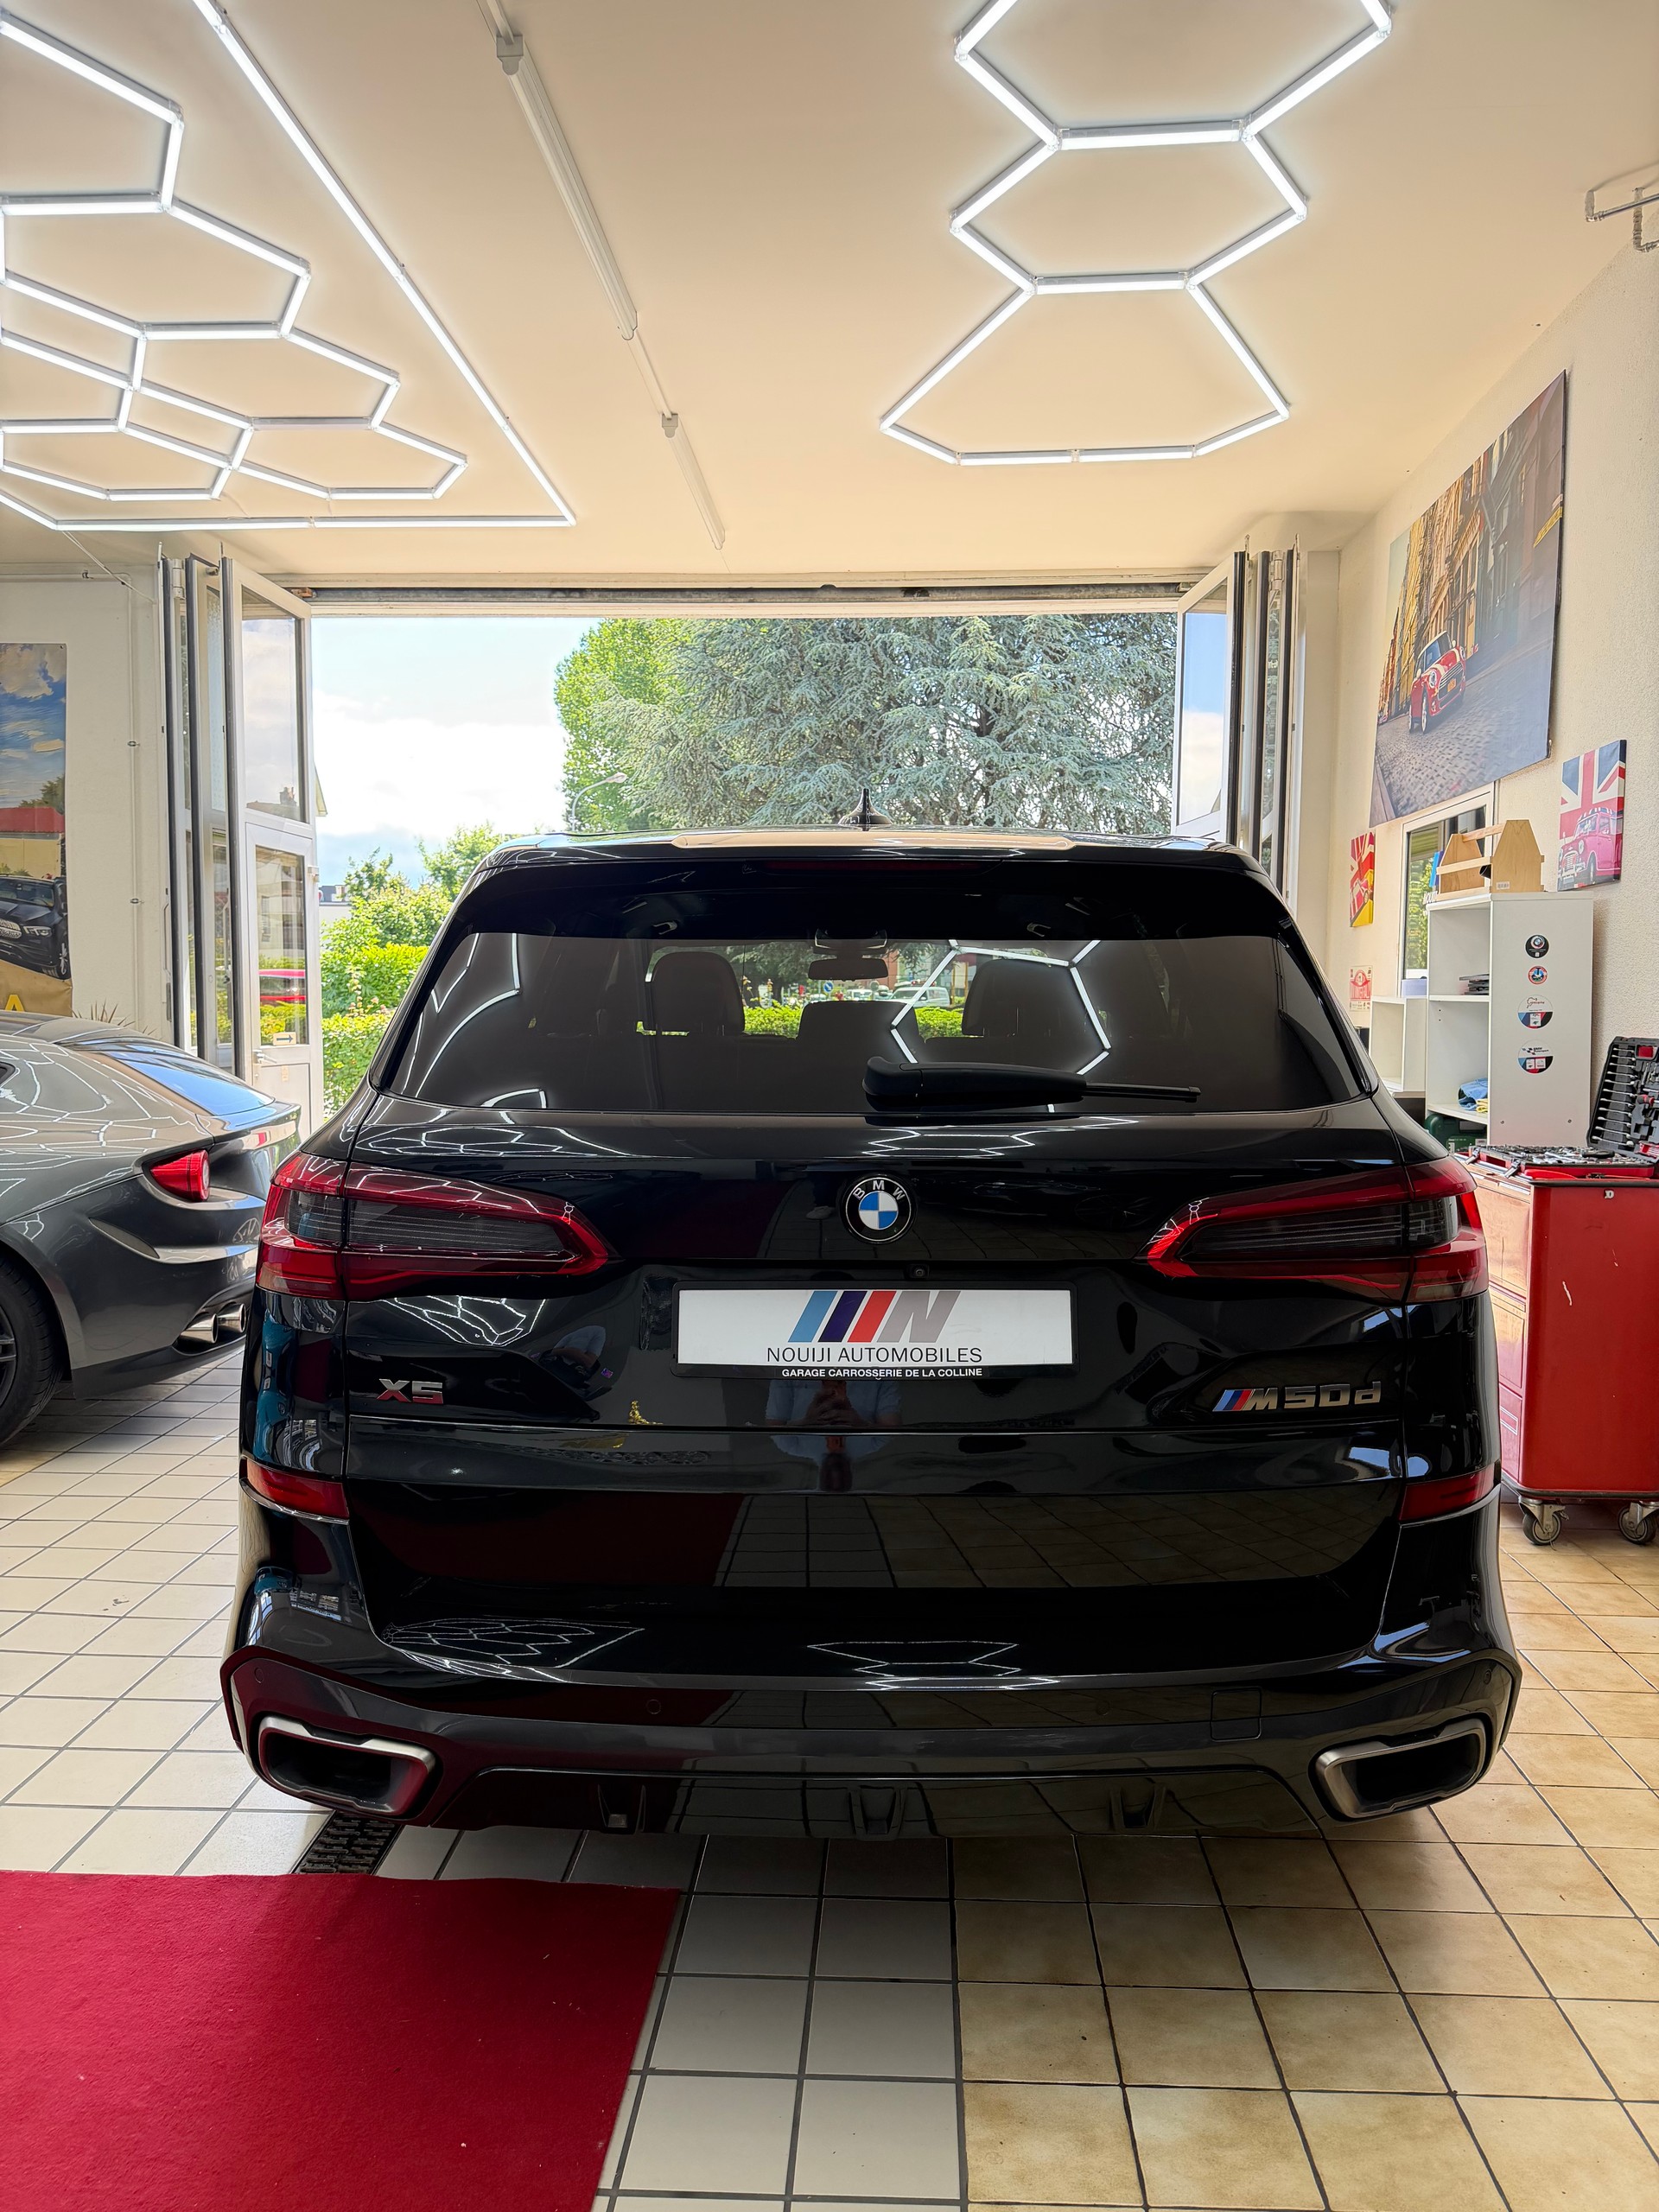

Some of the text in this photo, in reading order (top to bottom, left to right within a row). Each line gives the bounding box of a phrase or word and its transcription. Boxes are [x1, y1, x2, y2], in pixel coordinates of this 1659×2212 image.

[853, 1179, 906, 1200] BMW
[767, 1347, 982, 1363] NOUIJI AUTOMOBILES
[782, 1368, 982, 1377] GARAGE CARROSSERIE DE LA COLLINE
[377, 1378, 444, 1404] X5
